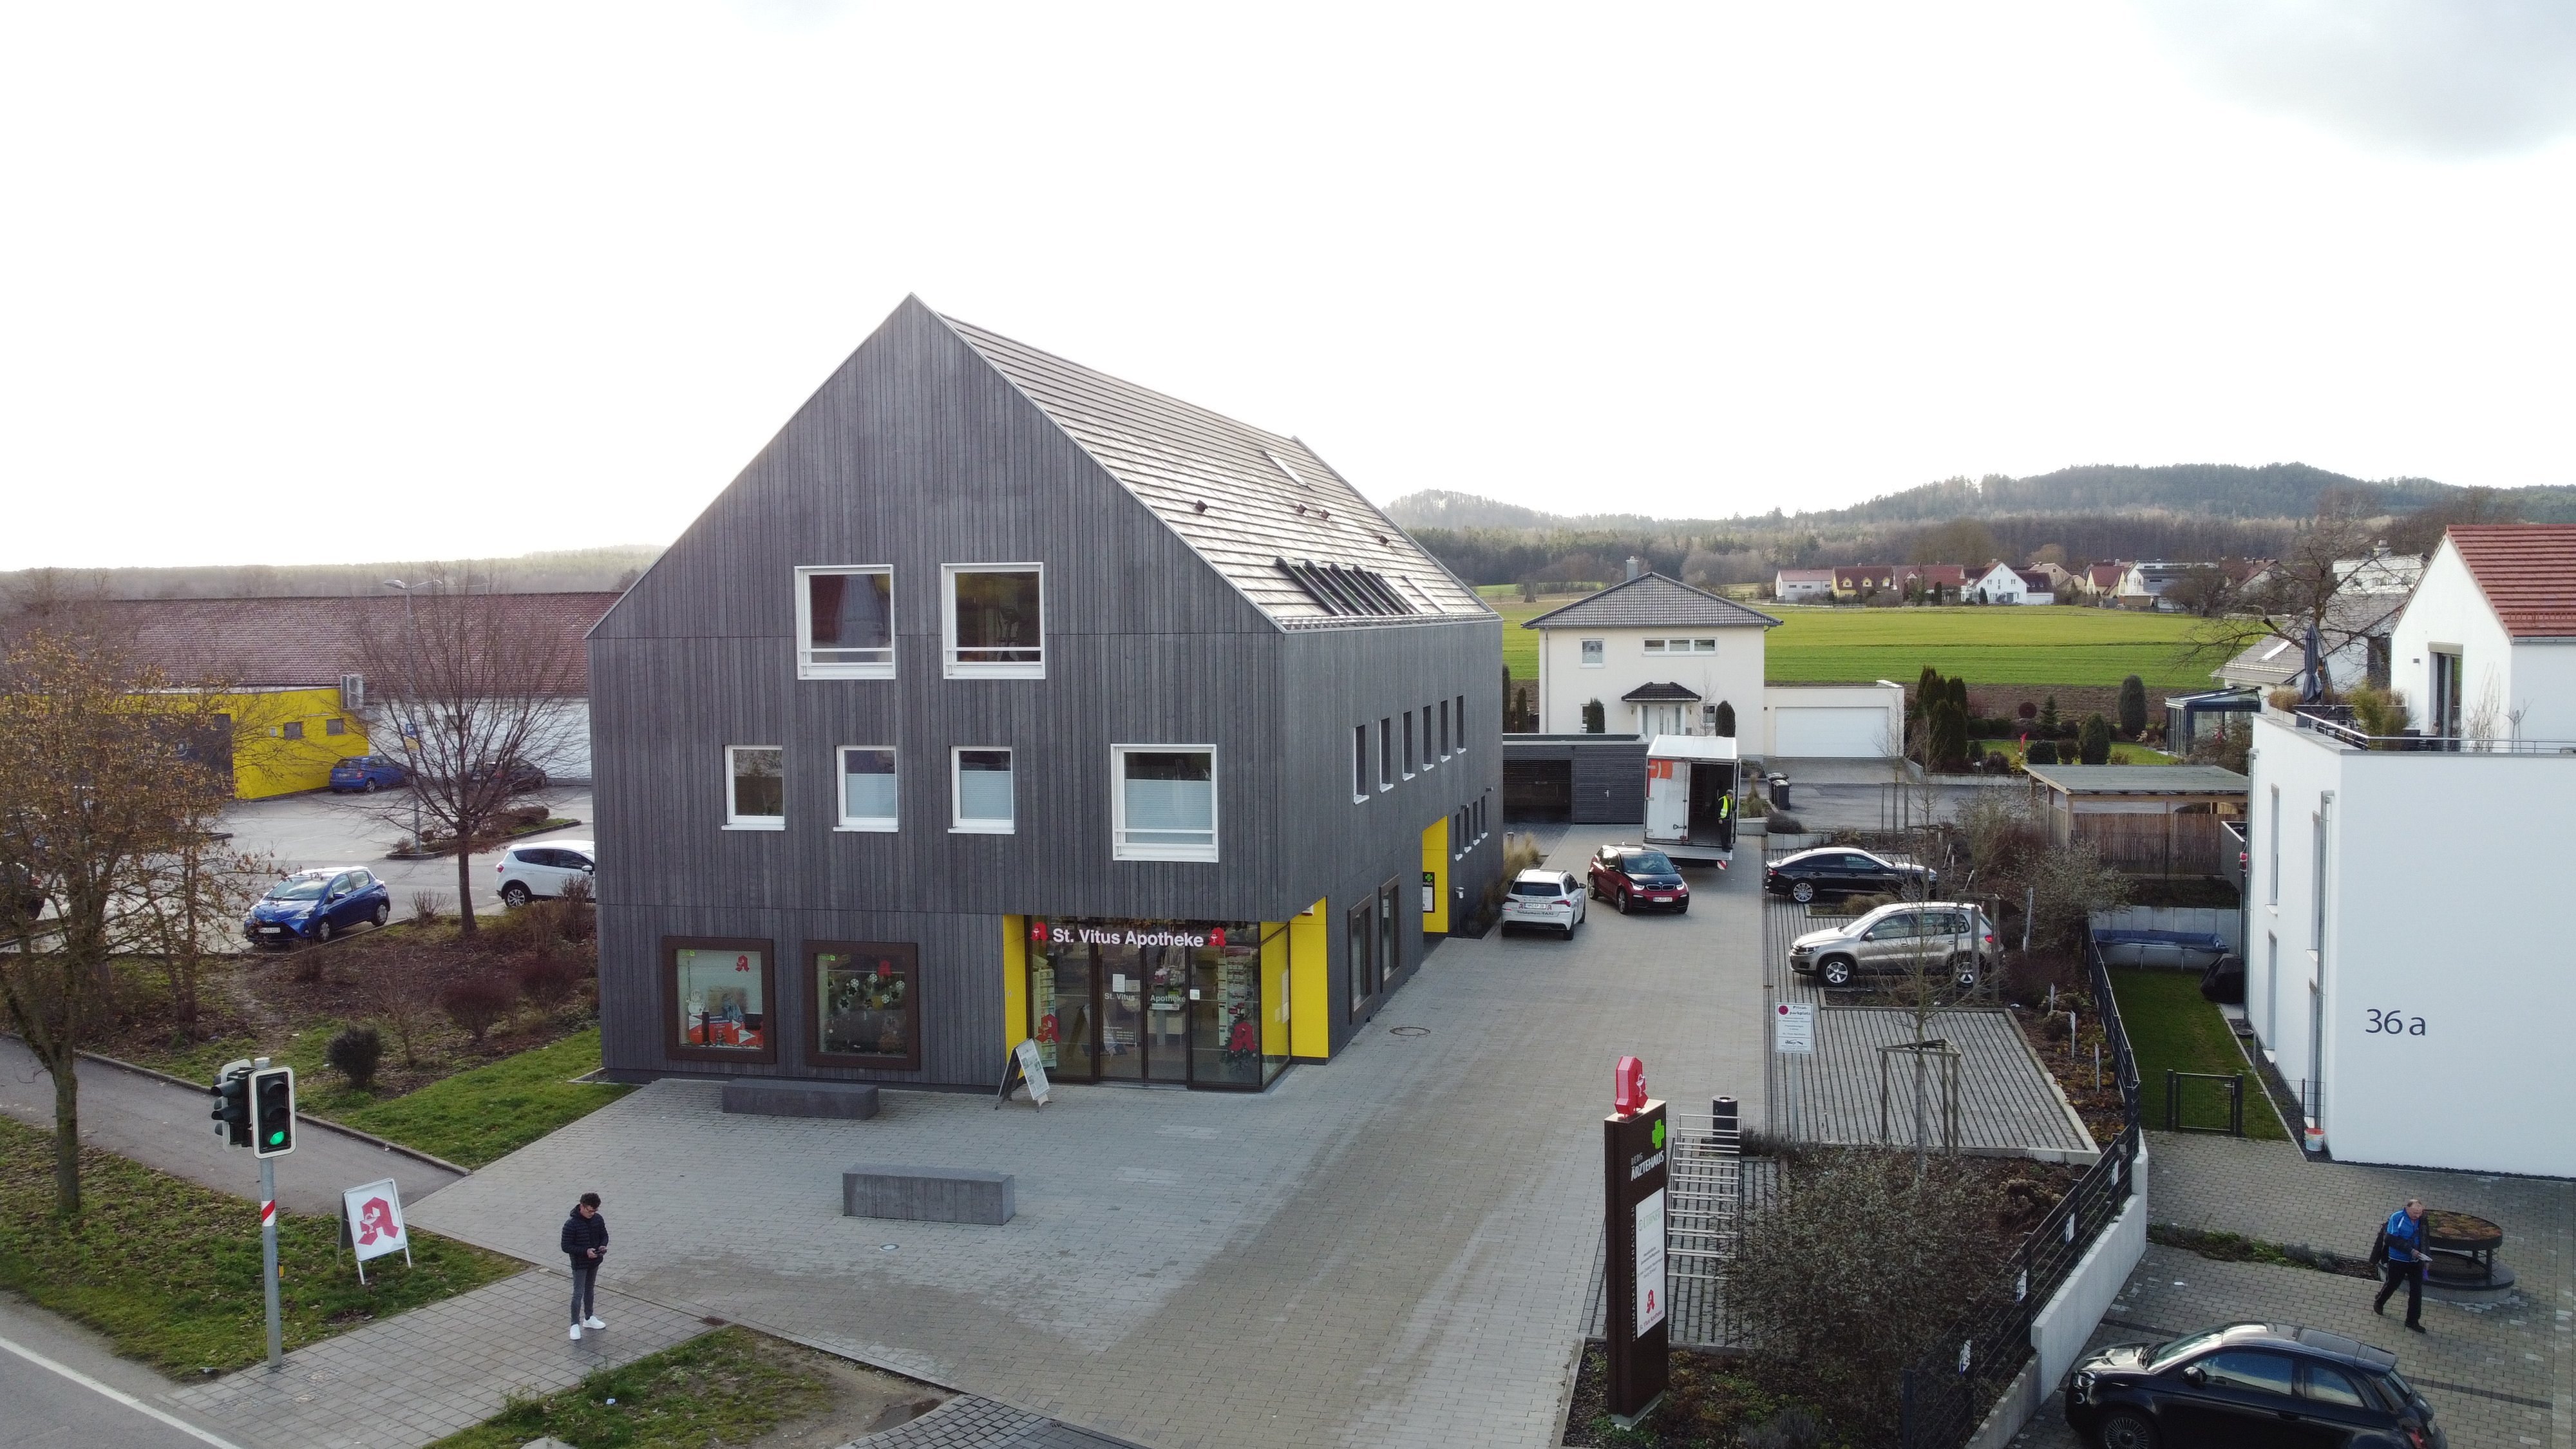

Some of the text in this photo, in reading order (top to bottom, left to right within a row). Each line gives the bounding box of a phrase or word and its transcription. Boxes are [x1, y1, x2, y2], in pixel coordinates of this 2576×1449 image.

[1053, 928, 1204, 949] St. Vitus Apotheke
[1631, 1152, 1643, 1166] BERG
[1631, 1150, 1665, 1182] ÄRZTEHAUS
